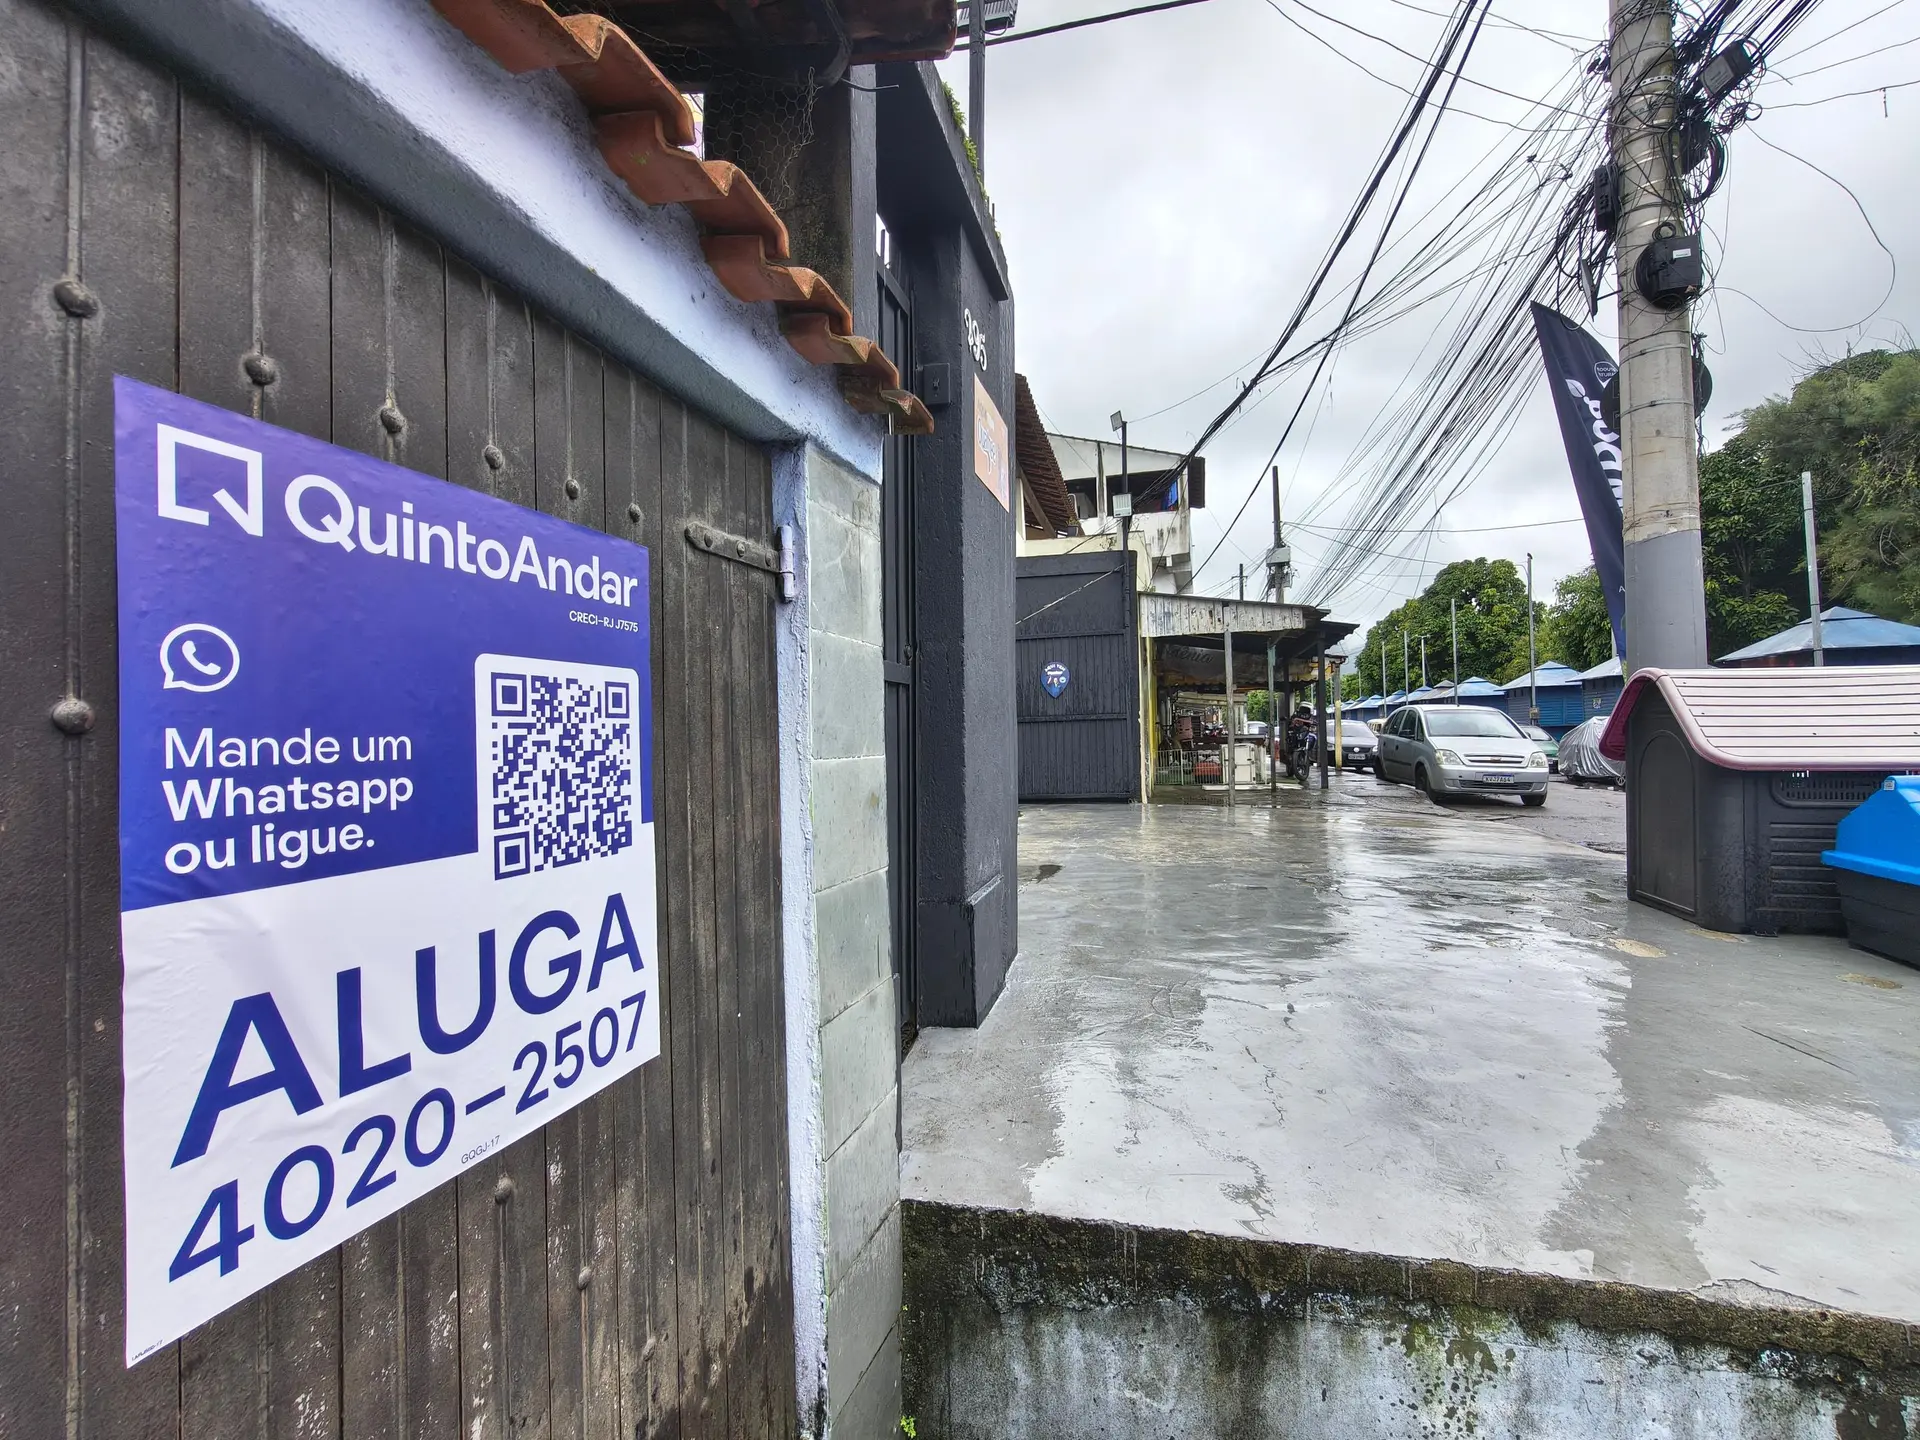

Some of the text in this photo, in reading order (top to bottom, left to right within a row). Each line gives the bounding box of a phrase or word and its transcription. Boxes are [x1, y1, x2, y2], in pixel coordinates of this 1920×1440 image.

[964, 307, 988, 371] 295
[284, 473, 638, 608] QuintoAndar
[569, 610, 639, 633] CRECI-RJ J7575
[163, 727, 412, 769] Mande um
[161, 775, 413, 822] Whatsapp
[164, 822, 375, 875] ou ligue.
[170, 892, 645, 1170] ALUGA
[168, 990, 647, 1283] 4020-2507
